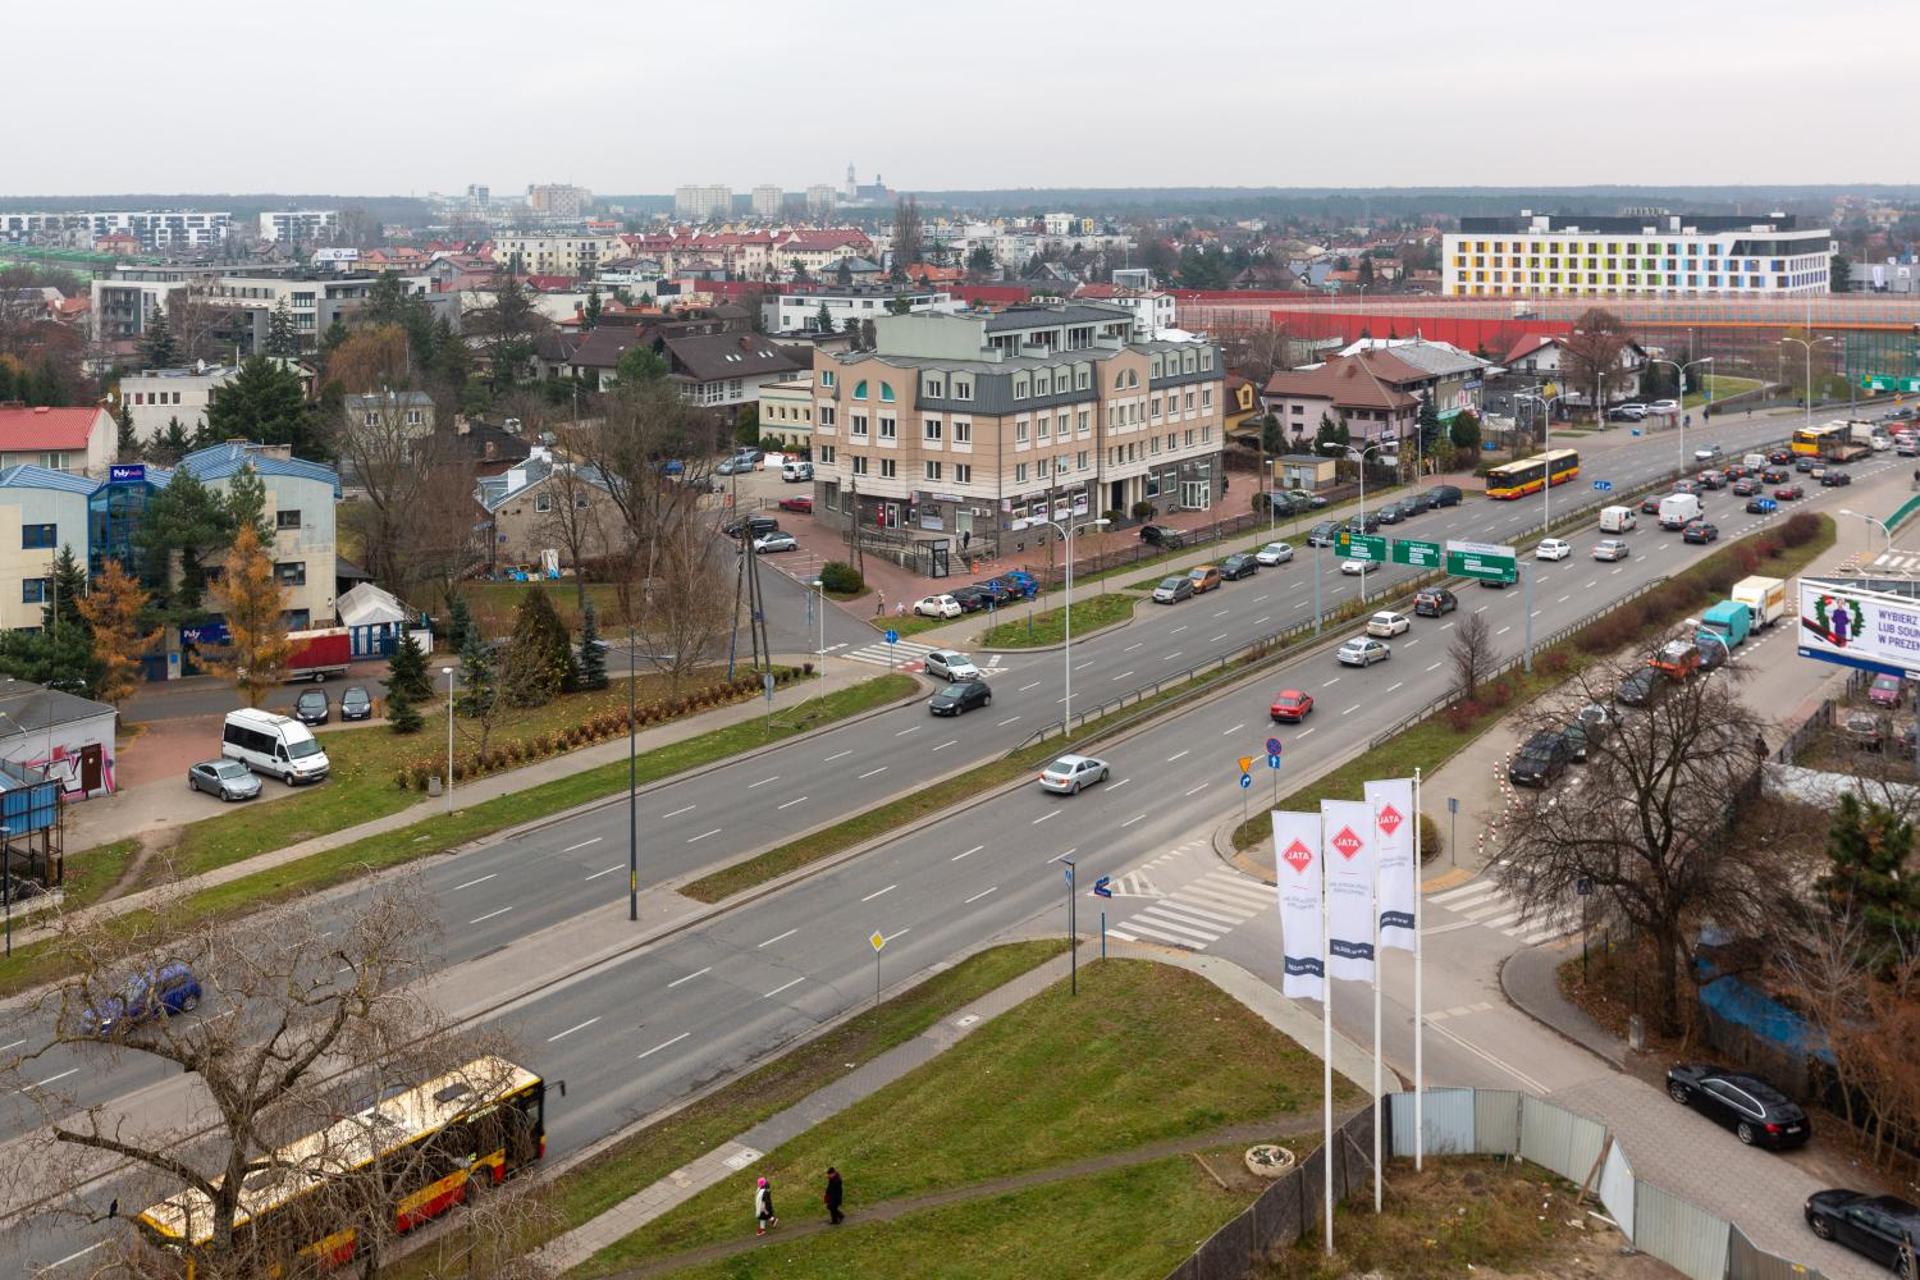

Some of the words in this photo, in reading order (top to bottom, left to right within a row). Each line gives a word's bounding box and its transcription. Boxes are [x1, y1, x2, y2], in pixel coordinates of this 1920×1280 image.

[1879, 610, 1917, 625] WYBIERZ
[1879, 622, 1895, 633] LUB
[1879, 634, 1886, 644] W
